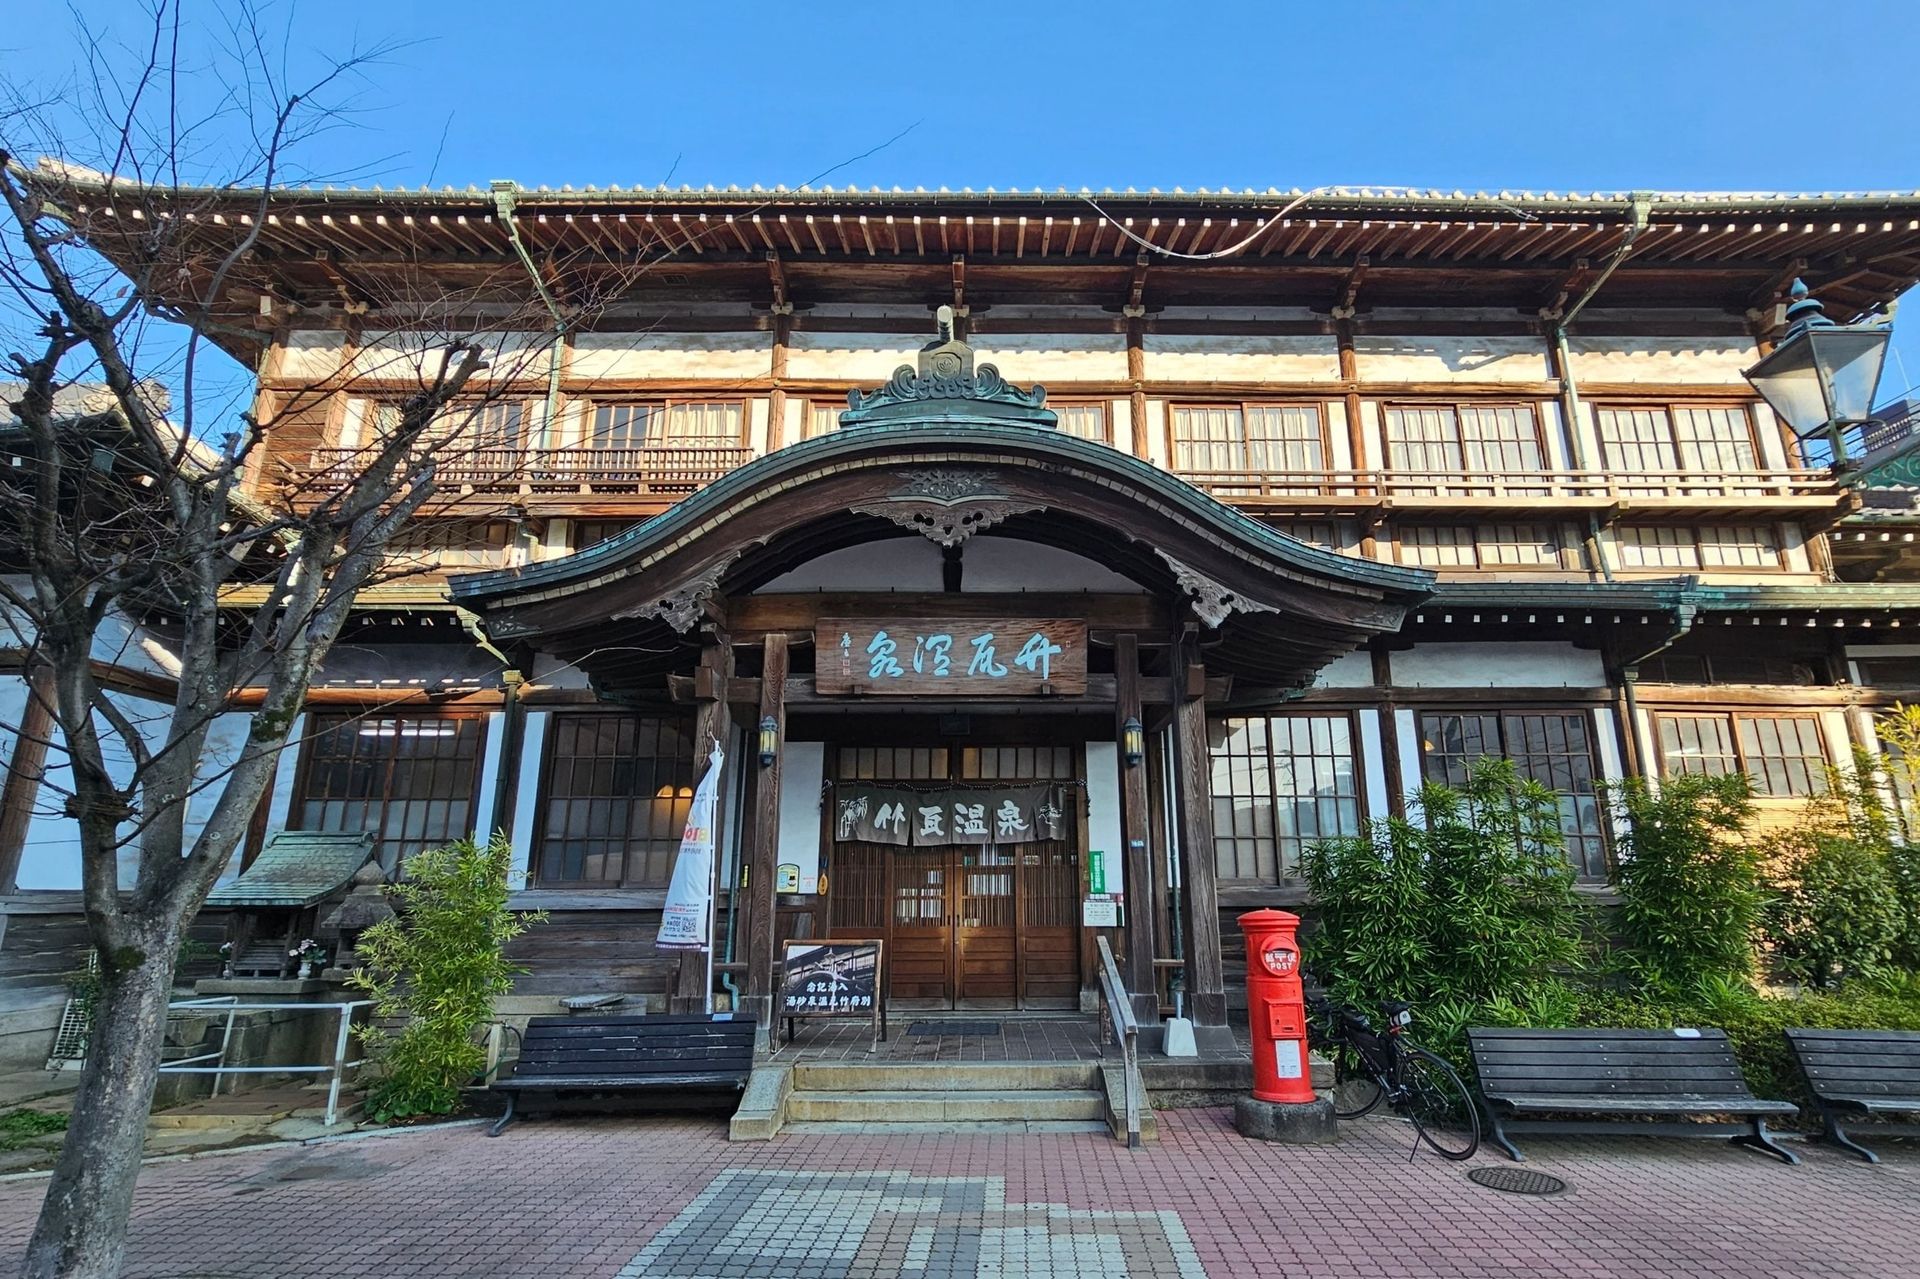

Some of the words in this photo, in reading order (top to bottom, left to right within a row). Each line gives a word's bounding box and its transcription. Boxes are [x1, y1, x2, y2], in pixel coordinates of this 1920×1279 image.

[874, 800, 1029, 836] 竹瓦温泉
[1270, 962, 1292, 970] POST
